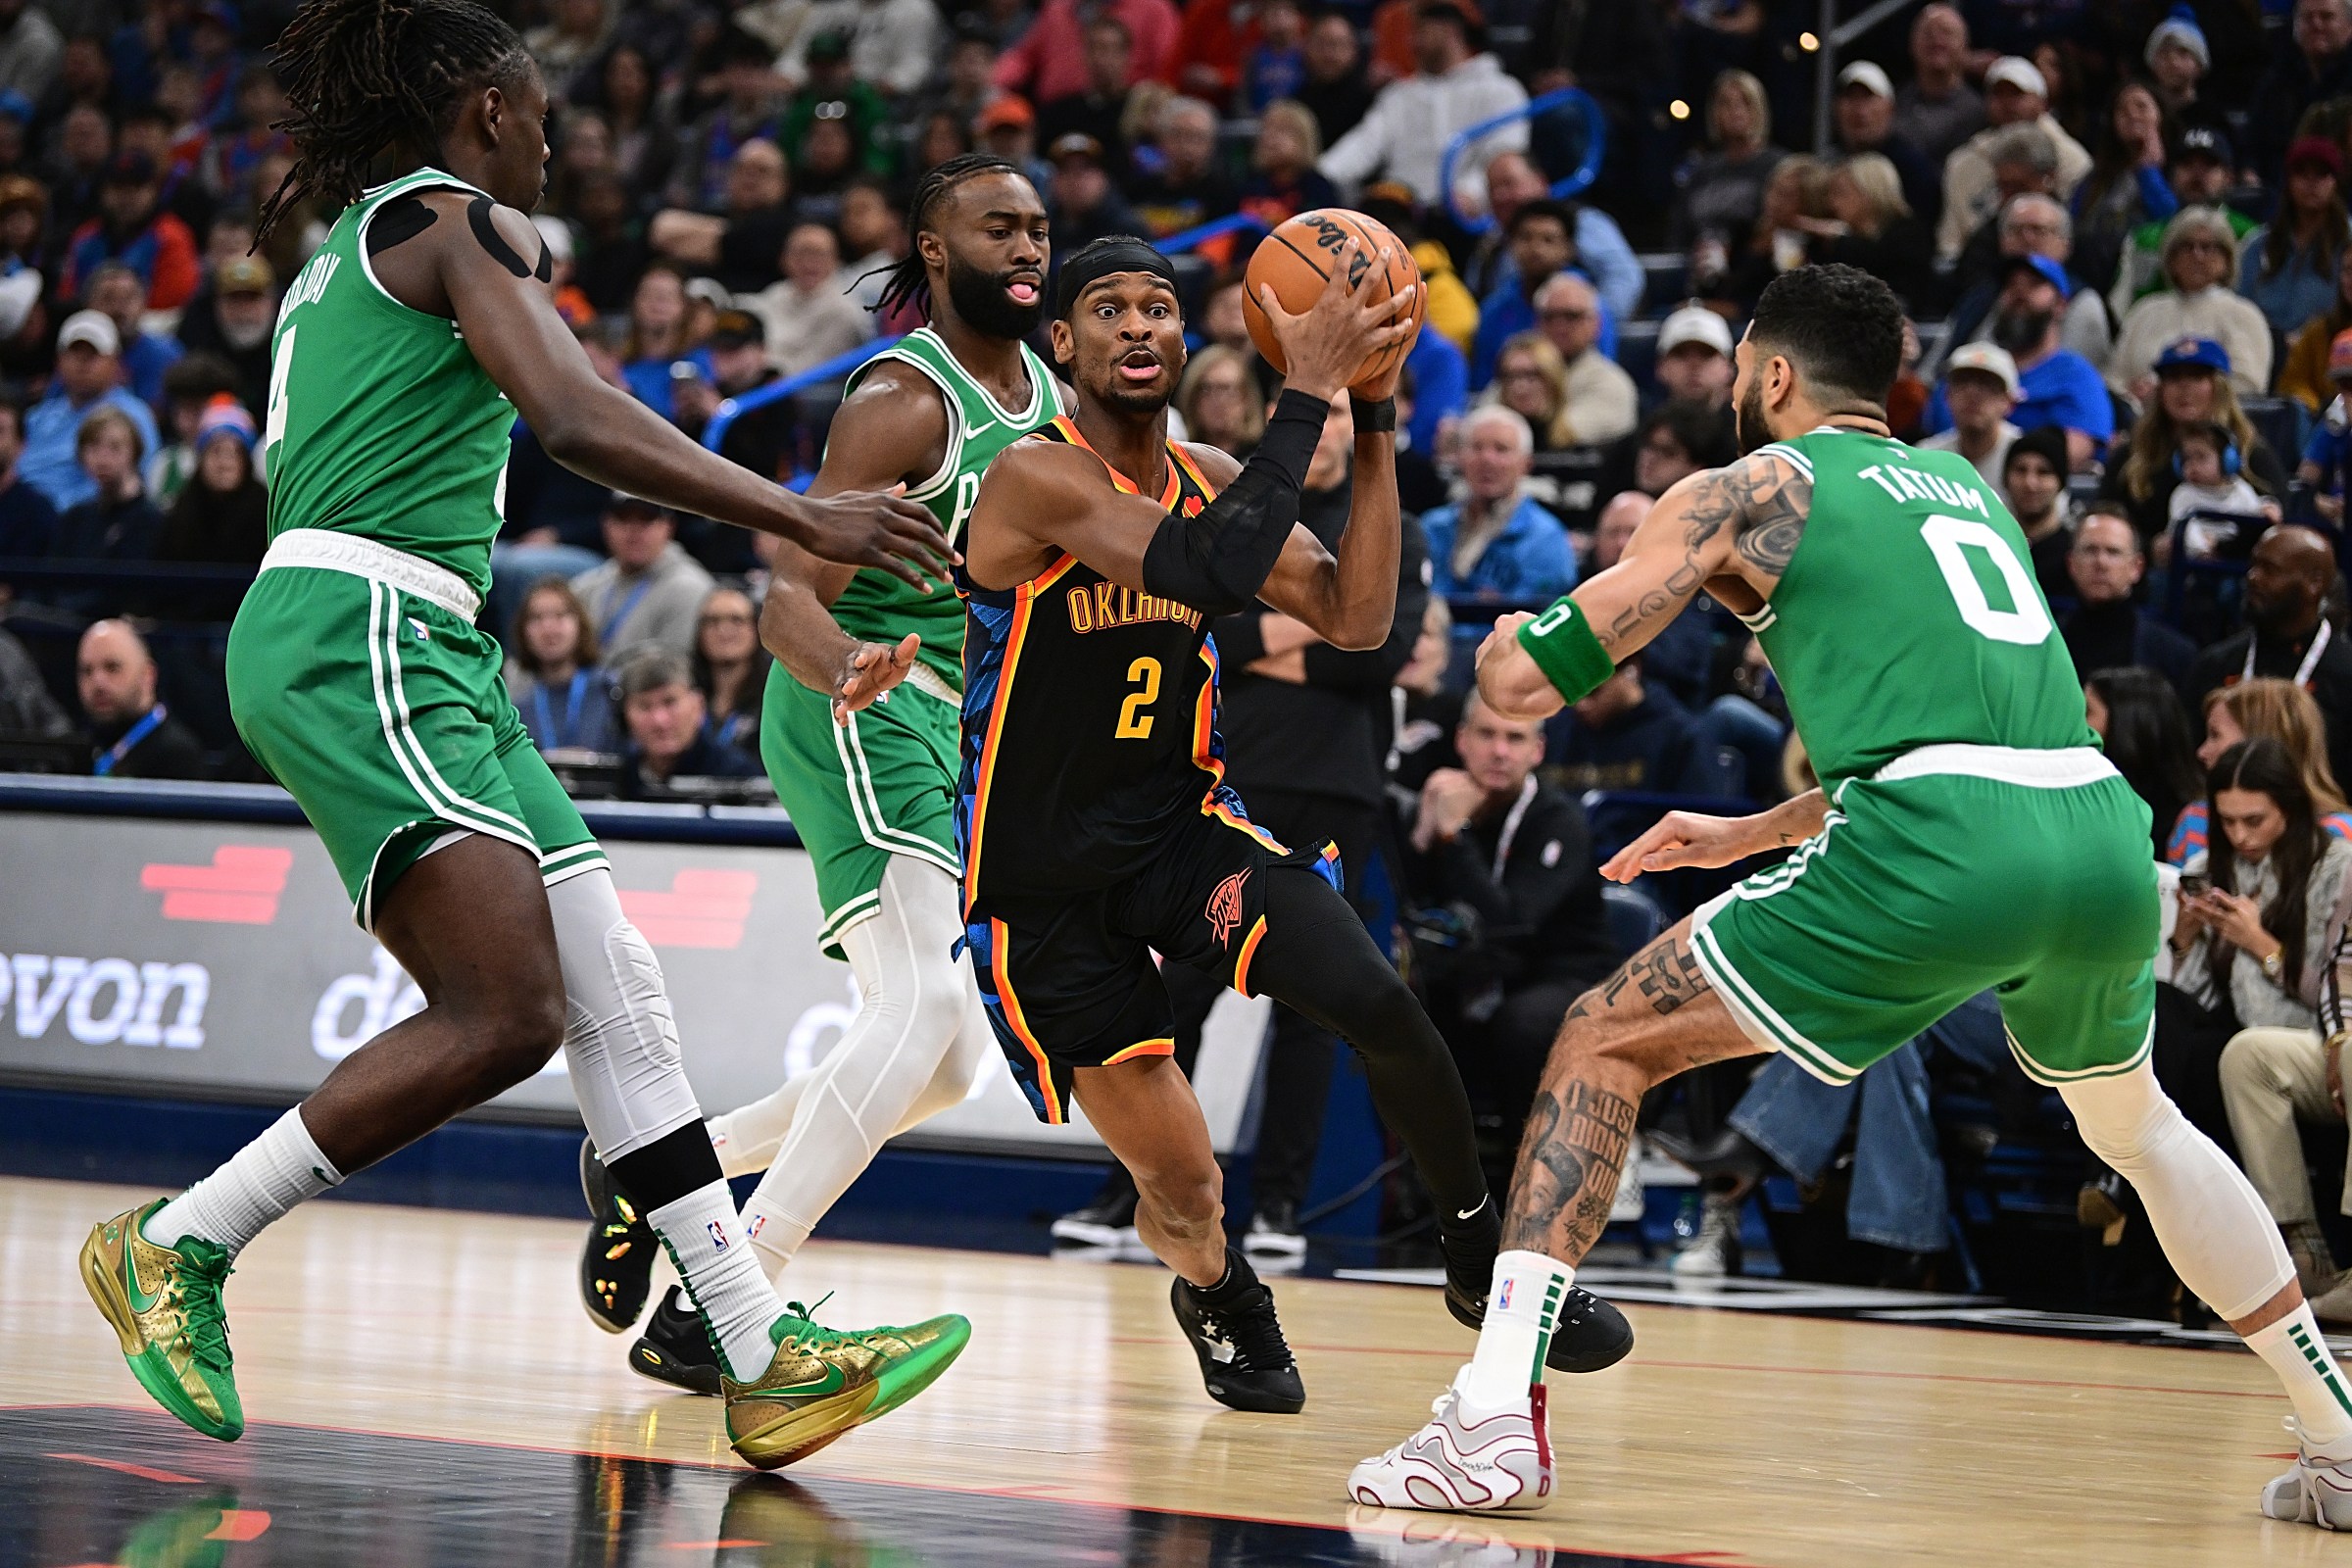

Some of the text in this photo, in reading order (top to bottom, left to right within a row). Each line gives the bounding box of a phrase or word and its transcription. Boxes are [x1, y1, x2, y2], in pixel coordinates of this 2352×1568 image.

[266, 324, 297, 451] 4
[1857, 464, 1989, 518] TATUM
[1529, 604, 1572, 637] 0
[1920, 514, 2053, 645] 0
[1114, 657, 1162, 739] 2
